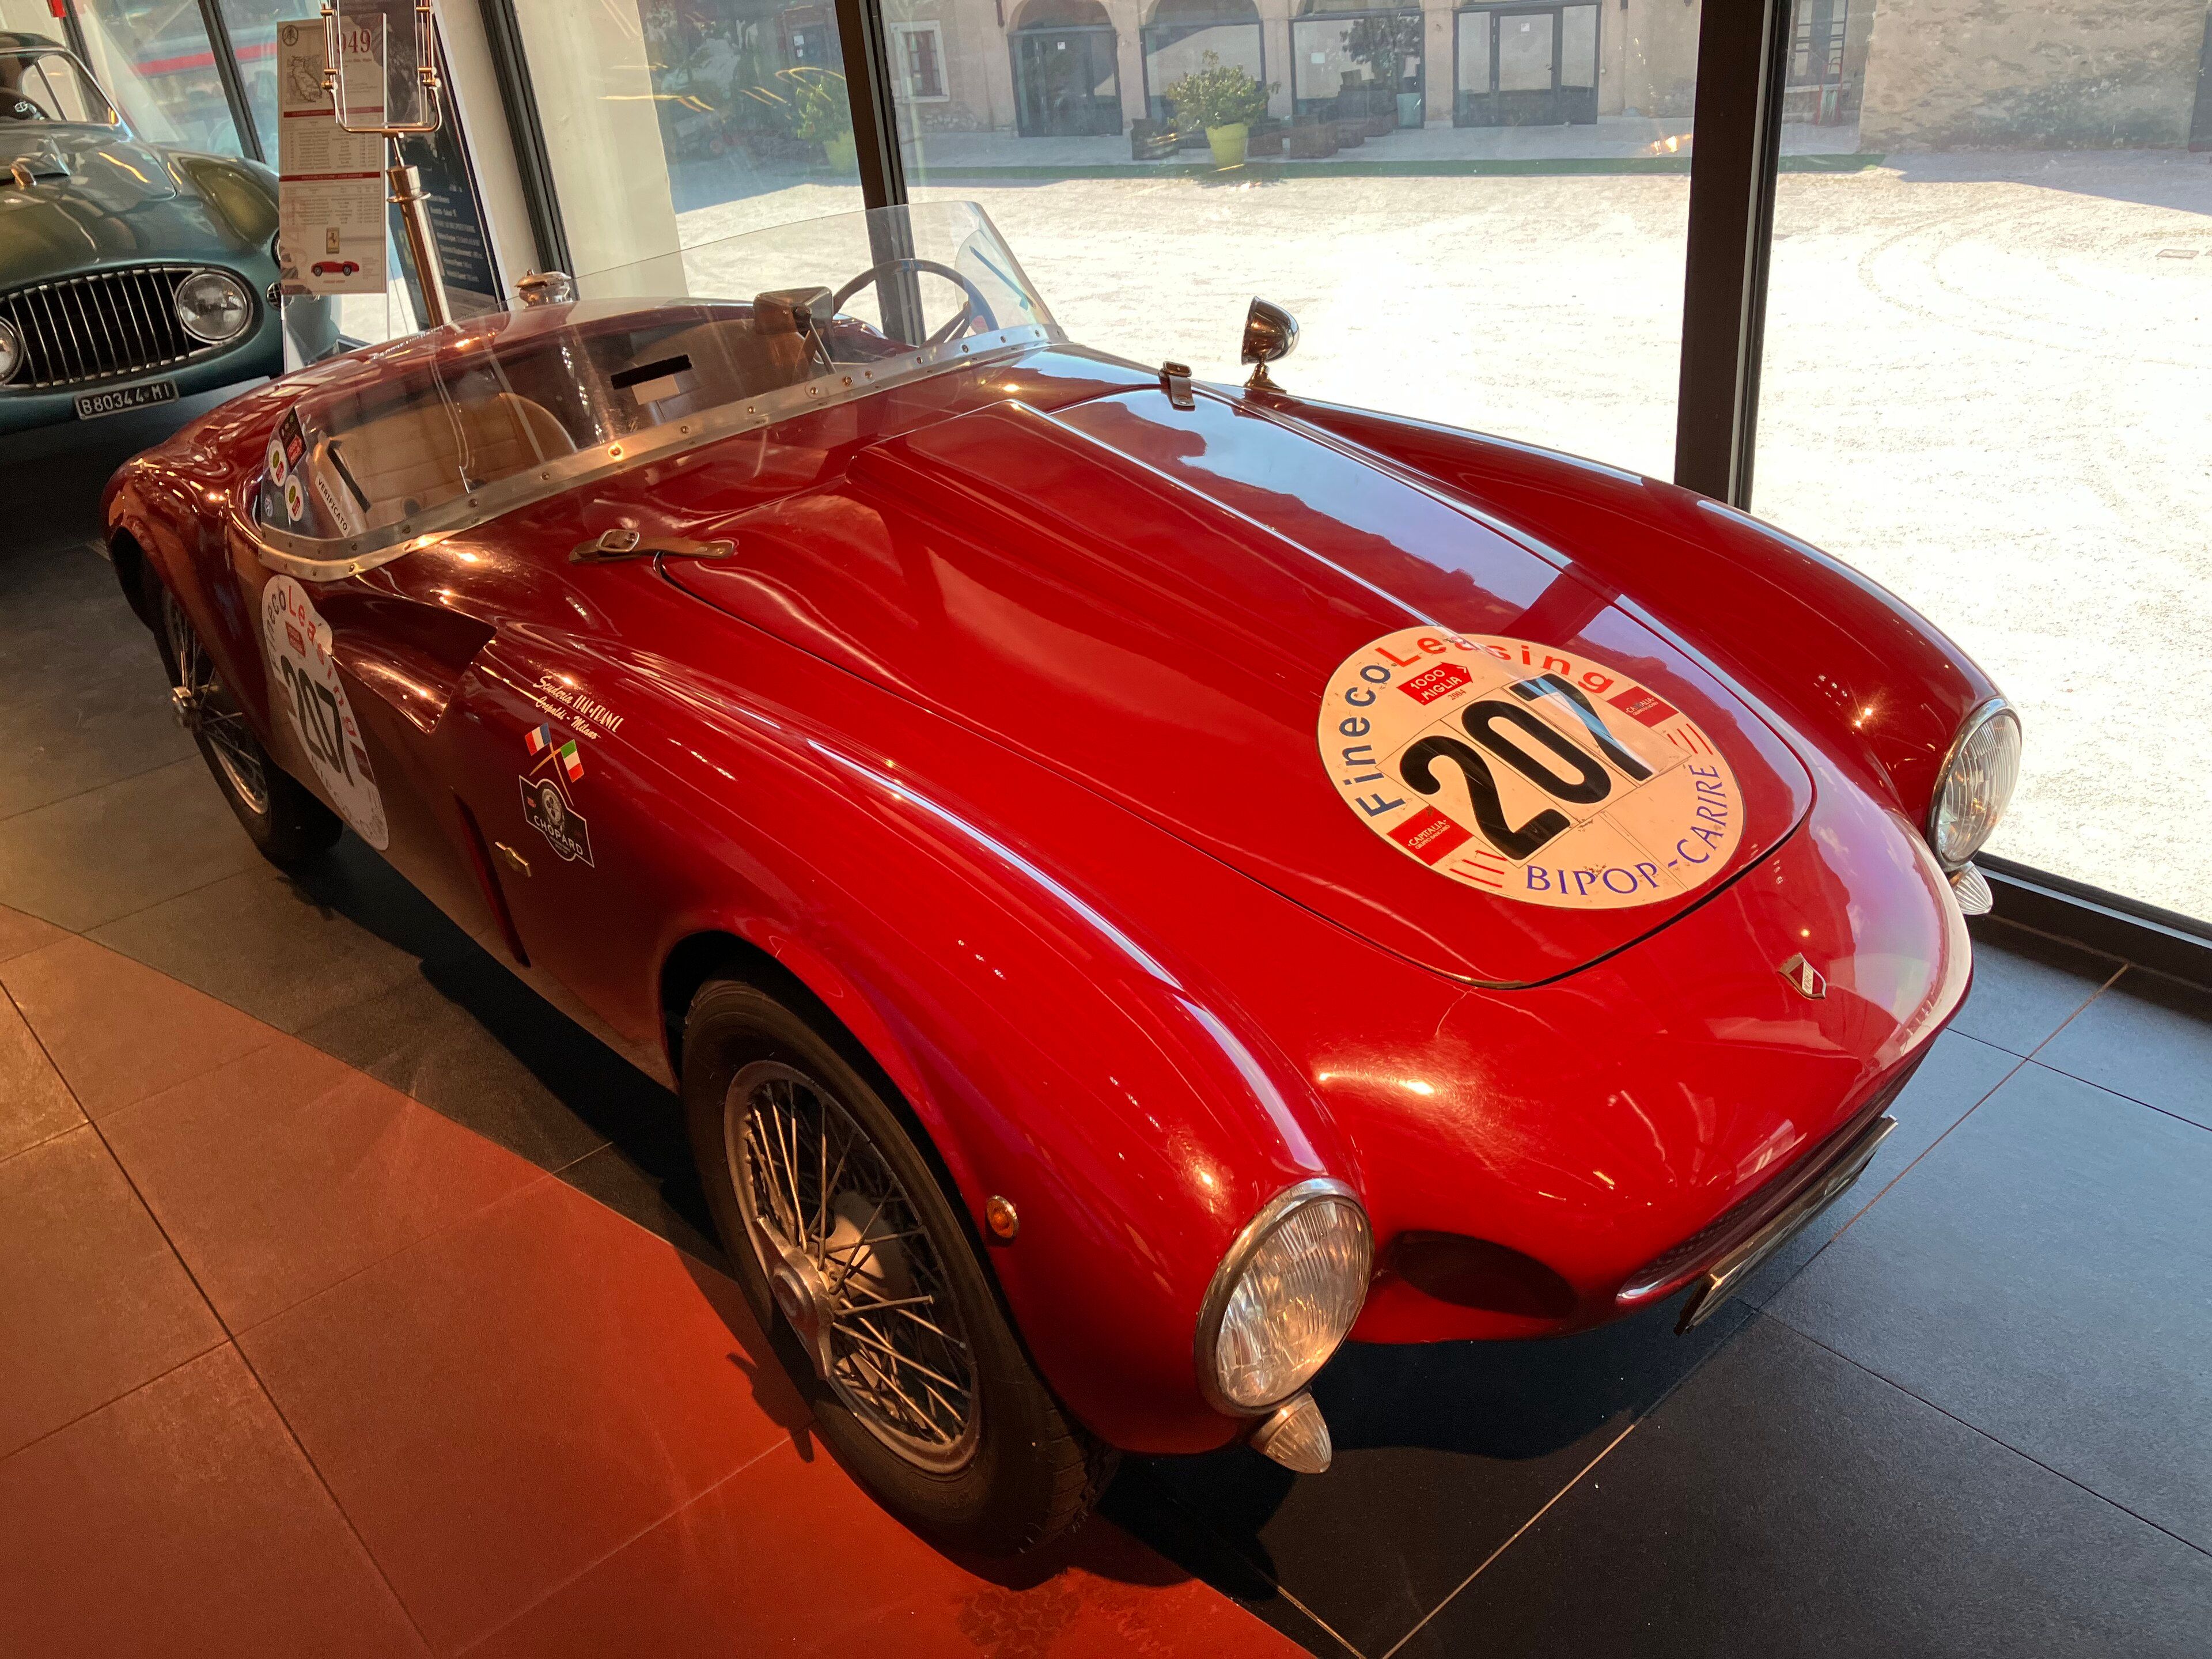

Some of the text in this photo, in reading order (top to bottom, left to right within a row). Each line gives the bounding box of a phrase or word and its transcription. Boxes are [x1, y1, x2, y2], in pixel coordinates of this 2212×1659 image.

[151, 383, 170, 400] MI
[318, 478, 347, 531] VERIFICATO
[532, 675, 574, 704] Scuderia
[1410, 669, 1445, 690] 1000
[1421, 676, 1463, 700] MIGLIA
[1447, 688, 1467, 700] 2004
[281, 654, 354, 787] 207
[570, 715, 601, 740] Milano
[1399, 673, 1654, 861] 207
[534, 815, 584, 856] CHOPARD
